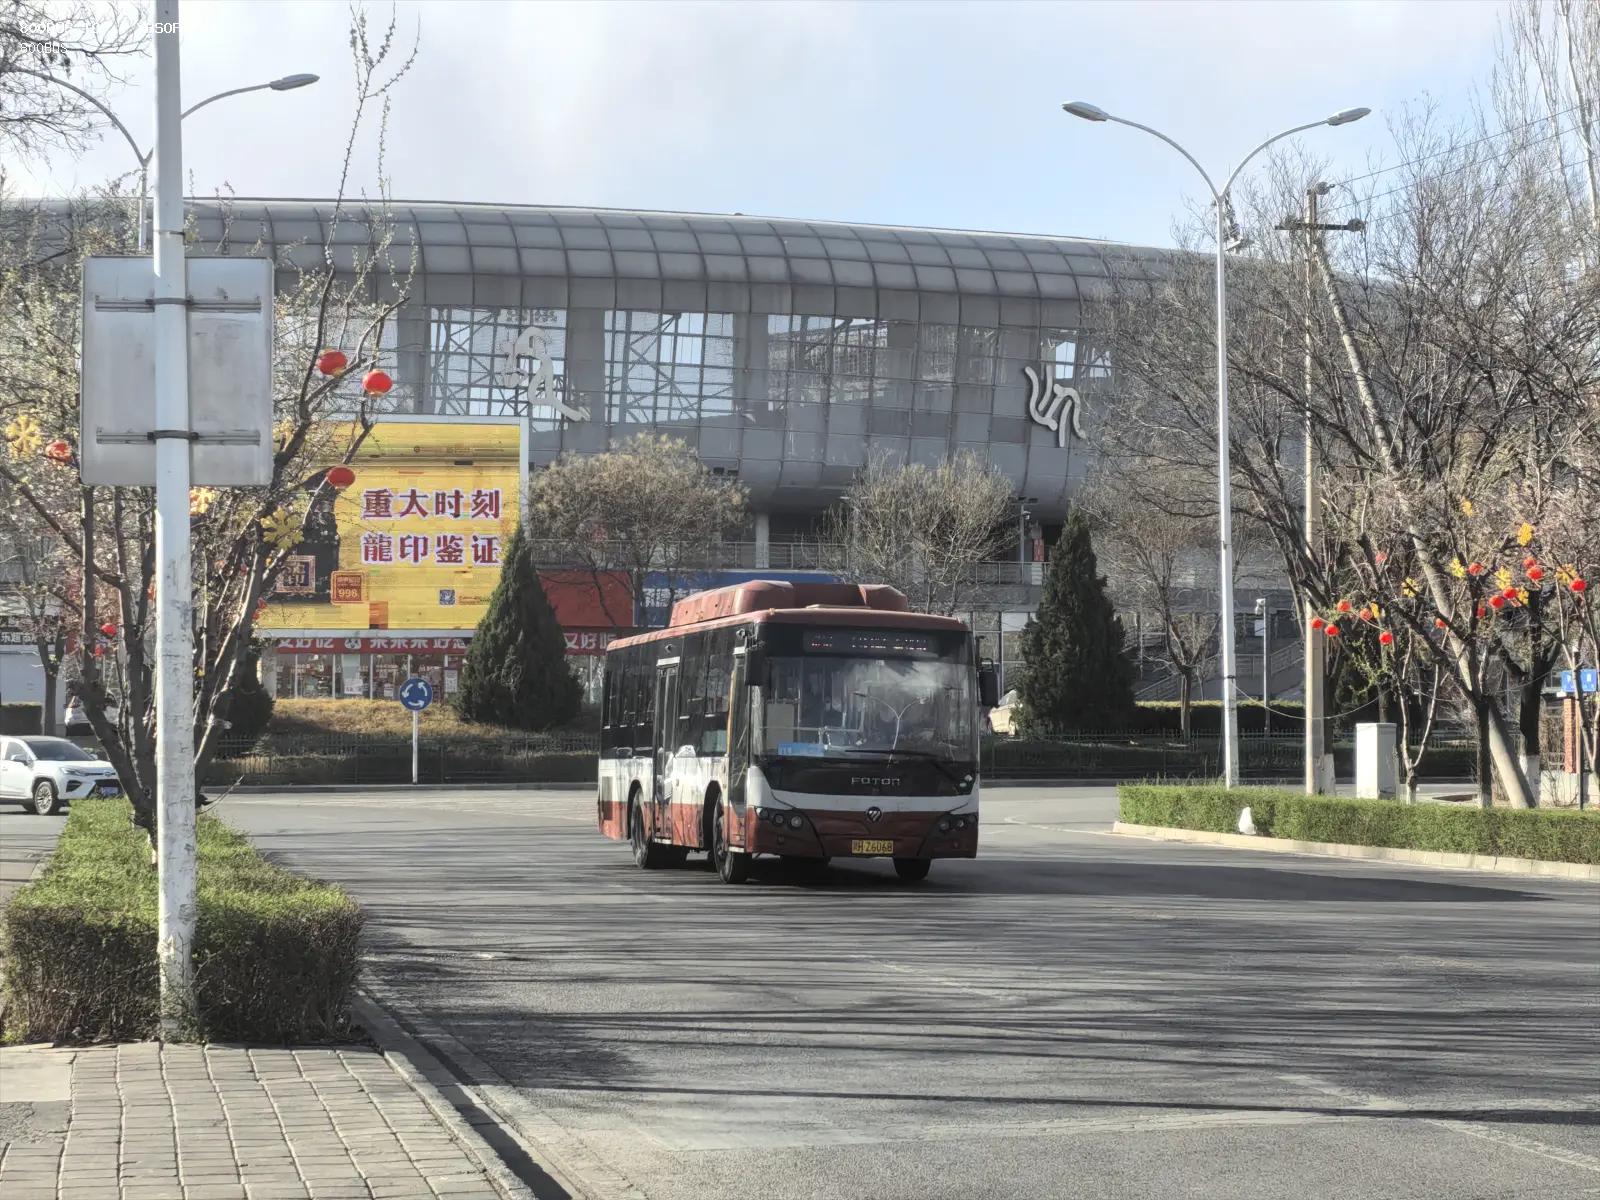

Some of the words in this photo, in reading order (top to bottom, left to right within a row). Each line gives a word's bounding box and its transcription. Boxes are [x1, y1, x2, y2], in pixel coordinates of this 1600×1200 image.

[361, 487, 501, 520] 重大时刻
[361, 532, 501, 564] 龍印鉴证
[851, 777, 900, 786] FOTON
